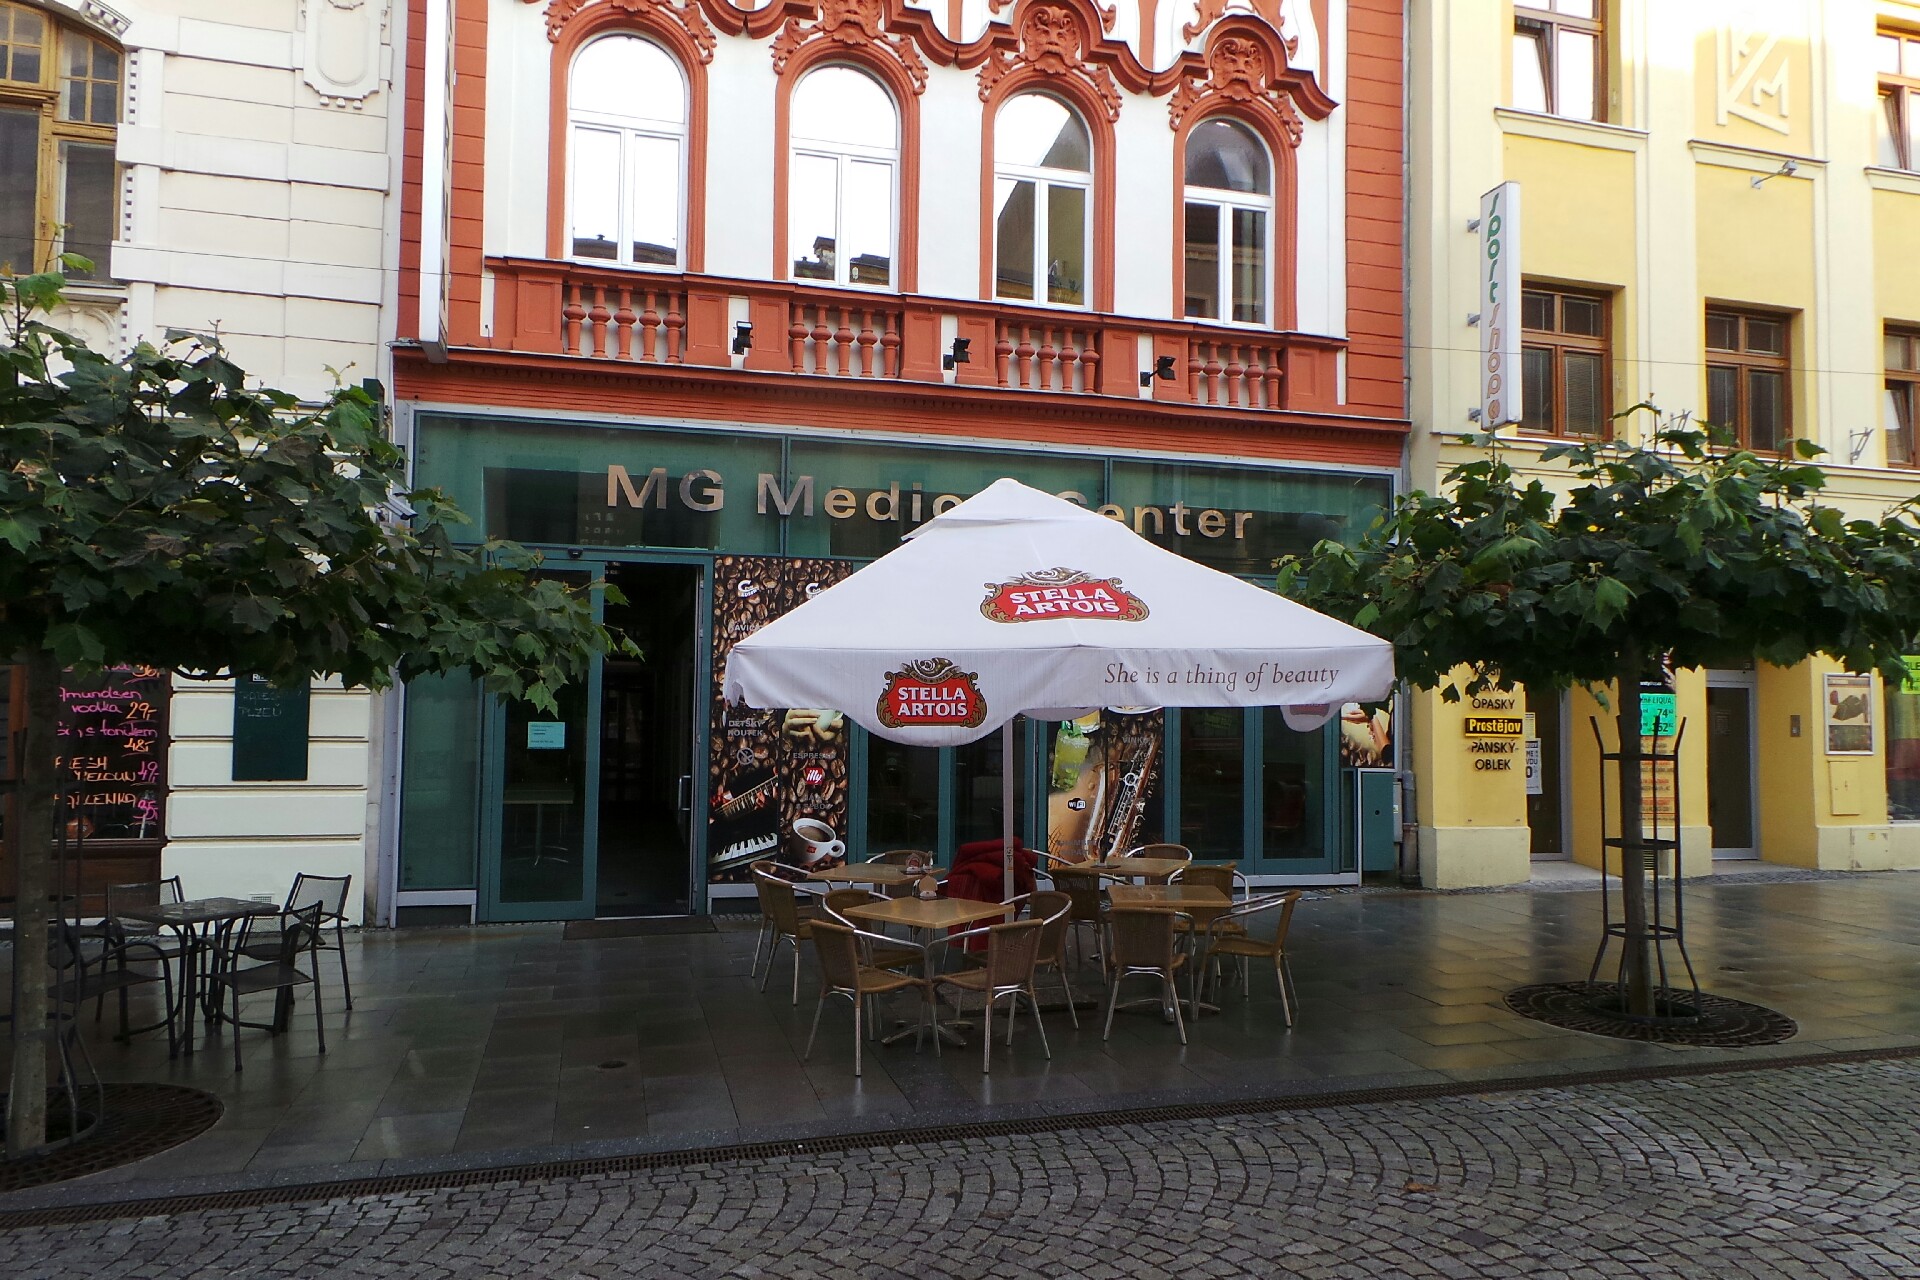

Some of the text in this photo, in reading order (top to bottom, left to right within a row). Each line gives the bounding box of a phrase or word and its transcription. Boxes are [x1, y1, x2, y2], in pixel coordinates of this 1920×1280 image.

[607, 464, 725, 513] MG
[1009, 588, 1113, 604] STELLA
[1015, 600, 1121, 615] ARTOIS
[1104, 662, 1340, 692] She is a thing of beauty
[898, 687, 967, 701] STELLA
[71, 701, 122, 714] vodka
[897, 702, 968, 716] ARTOIS
[1472, 698, 1516, 710] OPASKY
[1469, 718, 1522, 733] Prostějov
[1475, 758, 1512, 771] OBLEK
